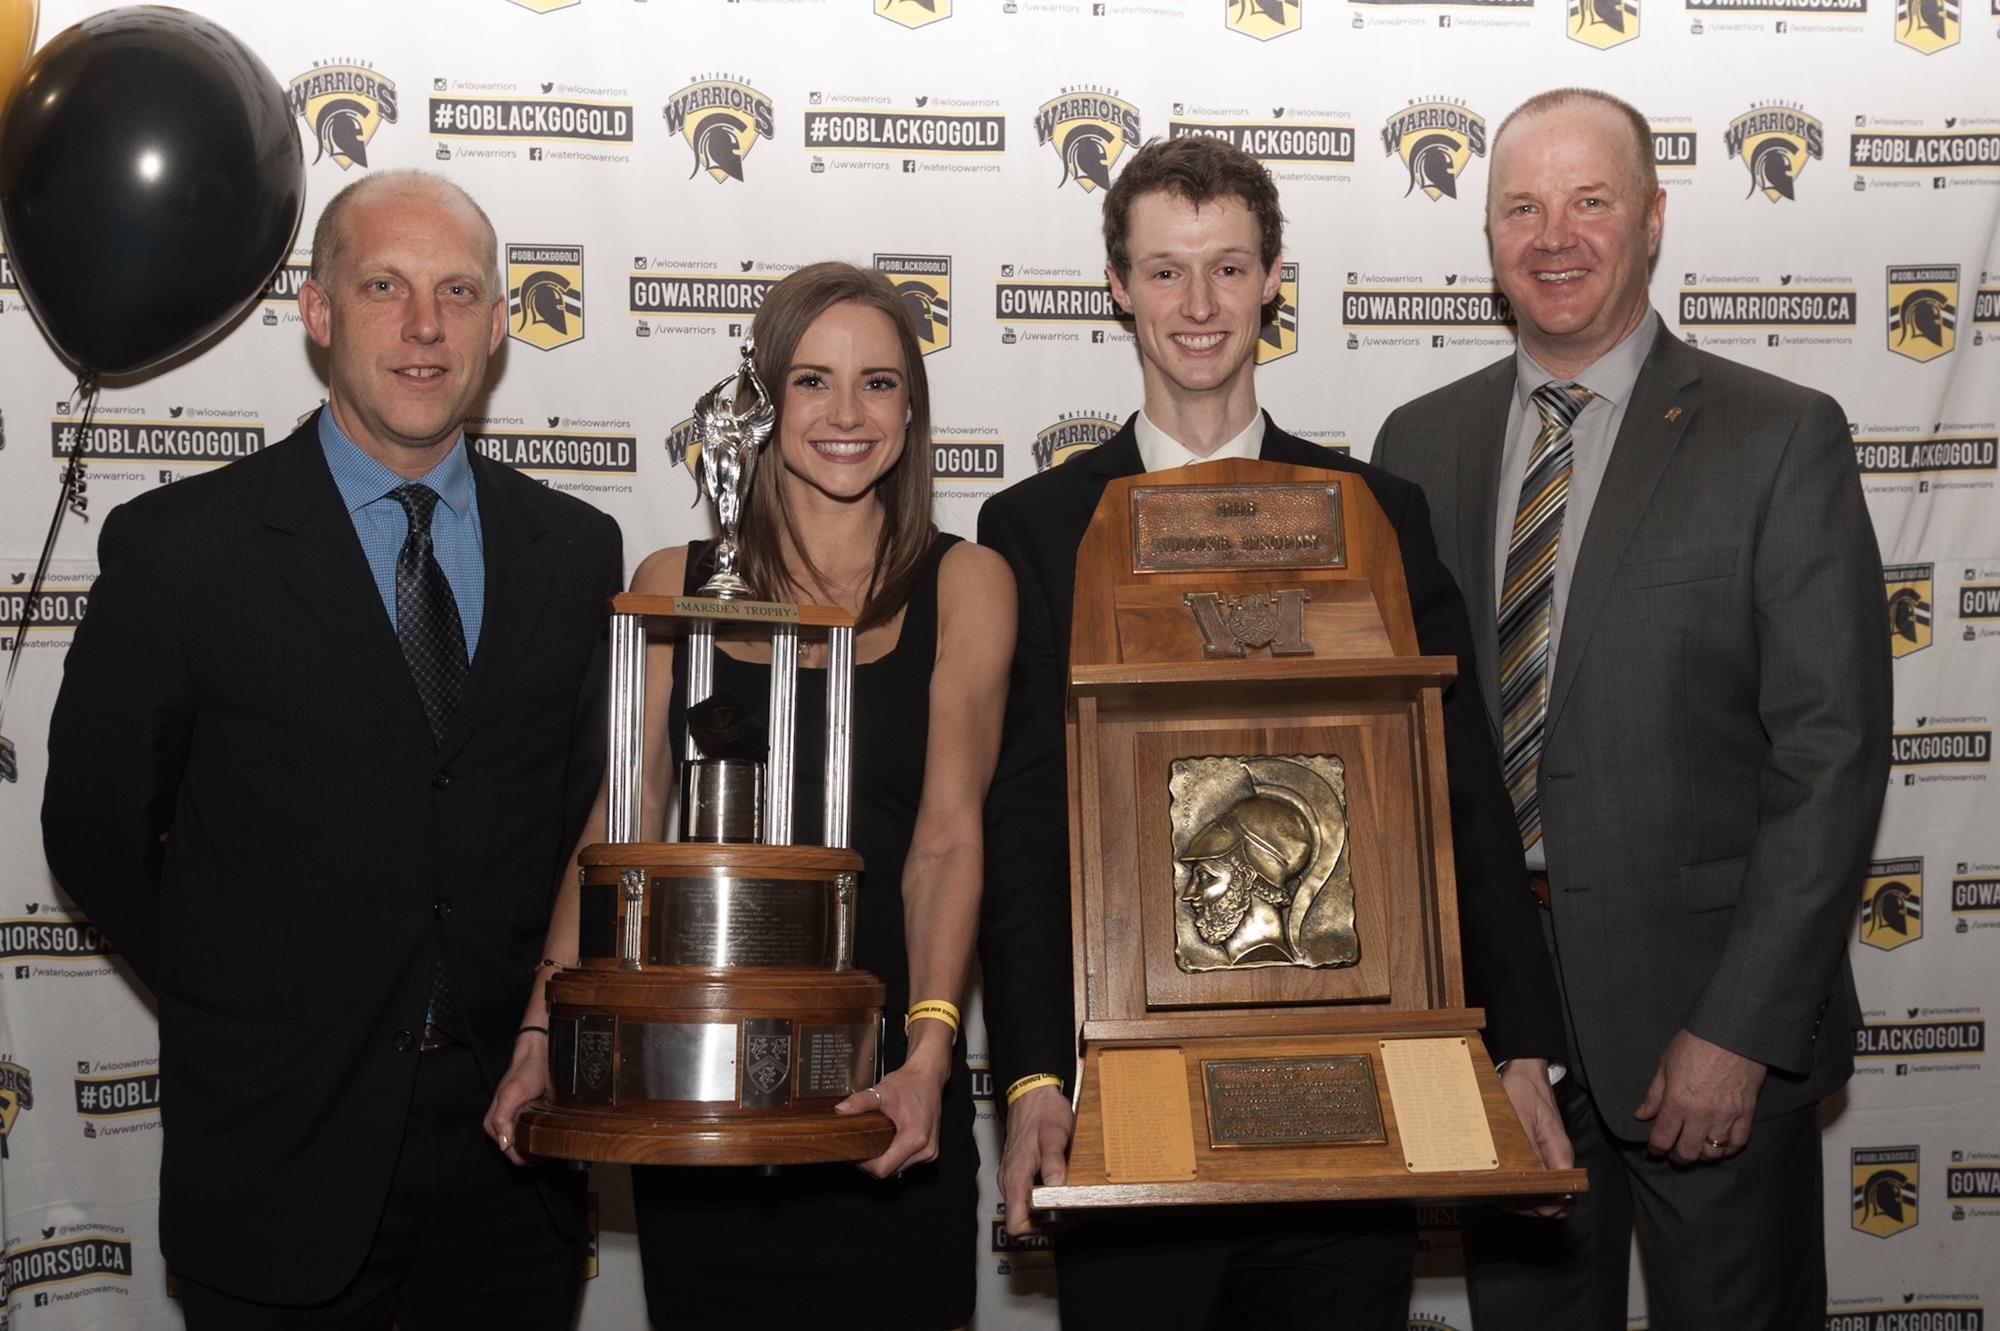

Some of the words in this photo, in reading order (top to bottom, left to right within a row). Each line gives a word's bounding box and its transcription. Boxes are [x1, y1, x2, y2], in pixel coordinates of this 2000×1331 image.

[451, 80, 518, 92] /wloowarriors
[289, 69, 399, 124] WARRIORS
[825, 92, 892, 105] /wloowarriors
[662, 86, 776, 140] WARRIORS
[434, 103, 627, 137] #GOBLACKGOGOLD
[1033, 98, 1141, 149] WARRIORS
[810, 117, 999, 146] #GOBLACKGOGOLD
[1380, 108, 1487, 157] WARRIORS
[1724, 112, 1824, 161] WARRIORS
[455, 147, 517, 159] /uwwarriors
[544, 150, 629, 164] /waterloowarriors
[829, 159, 890, 170] /uwwarriors
[918, 161, 1001, 173] /waterloowarriors
[511, 250, 578, 263] #GOBLACKGOGOLD
[651, 257, 718, 269] /wloowarriors
[878, 260, 947, 273] #GOBLACKGOGOLD
[1017, 265, 1081, 277] /wloowarriors
[1360, 273, 1423, 284] /wloowarriors
[1700, 274, 1759, 284] /wloowarriors
[1683, 296, 1849, 320] GOWARRIORSGO.CA
[654, 324, 716, 336] /uwwarriors
[1020, 331, 1079, 342] /uwwarriors
[1362, 336, 1420, 347] /uwwarriors
[1702, 336, 1756, 346] /uwwarriors
[186, 407, 258, 418] @wloowarriors
[560, 418, 630, 428] @wloowarriors
[474, 438, 630, 467] OBLACKGOGOLD
[552, 482, 632, 493] /waterloowarriors
[681, 602, 739, 615] MARSDEN
[743, 605, 791, 618] TROPHY
[1857, 1026, 1979, 1051] BLACKGOGOLD
